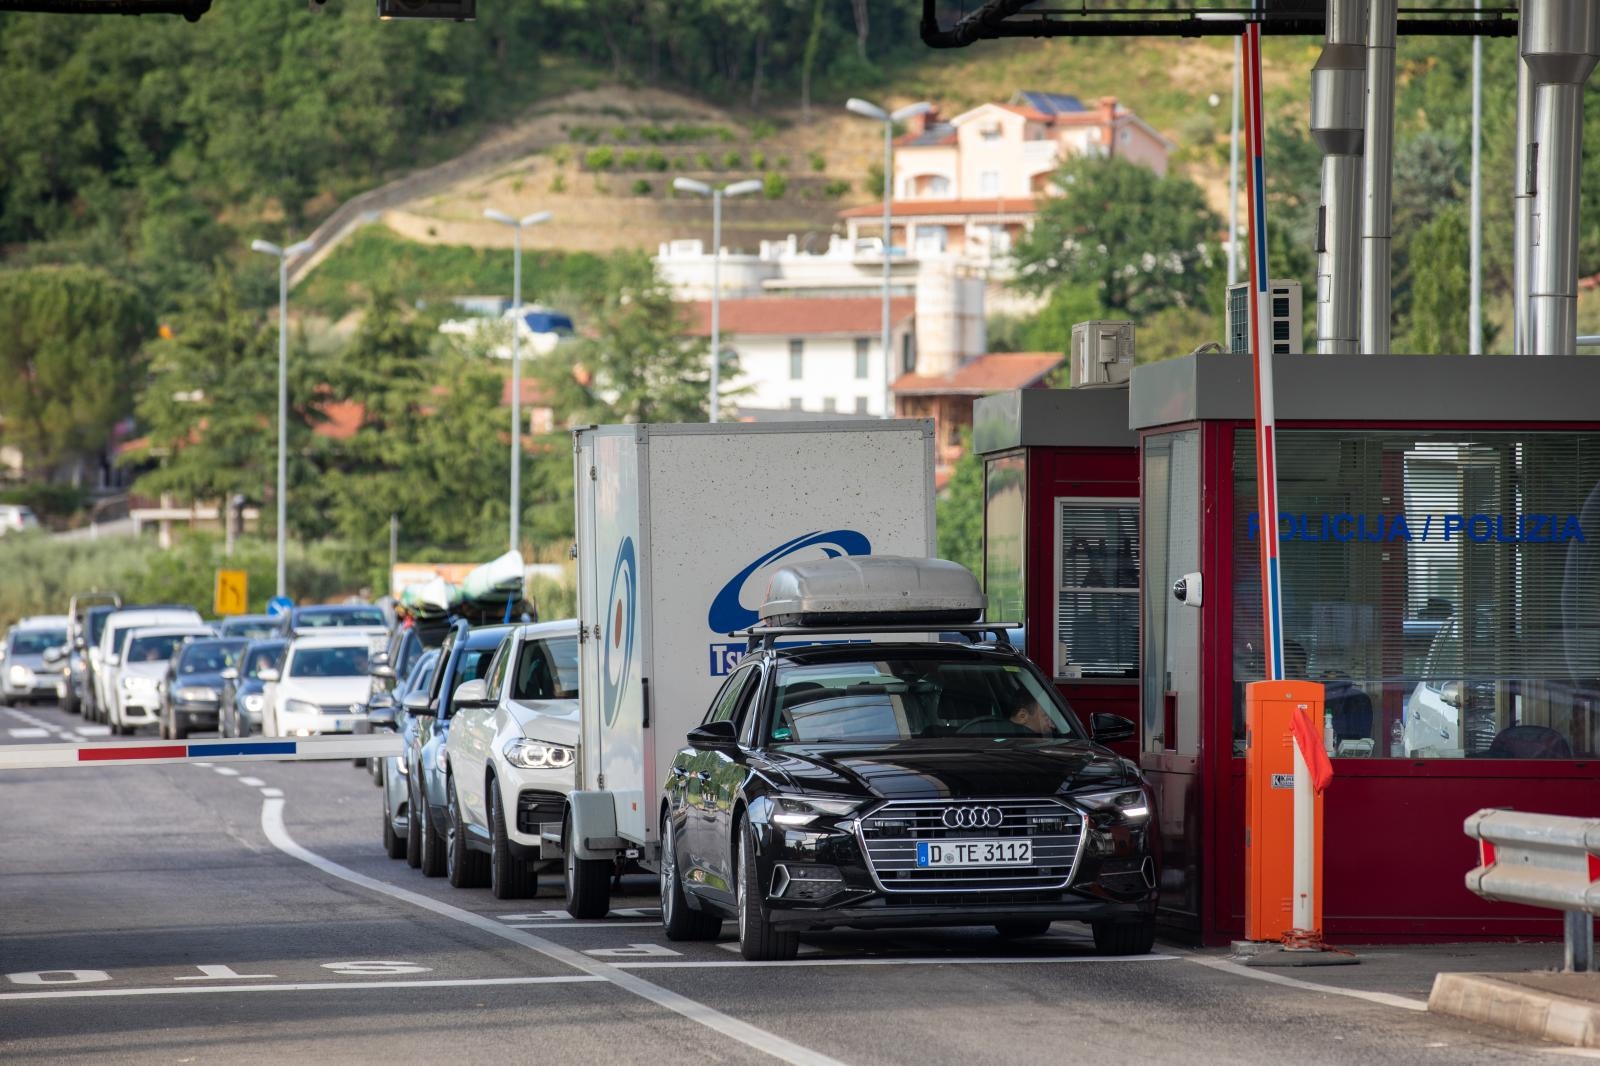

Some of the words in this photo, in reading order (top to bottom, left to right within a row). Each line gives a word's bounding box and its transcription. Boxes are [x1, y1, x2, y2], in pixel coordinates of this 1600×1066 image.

[1247, 512, 1412, 542] POLICIJA
[1422, 514, 1432, 542] /
[1444, 514, 1585, 542] POLIZIA
[930, 845, 942, 863] D
[955, 844, 979, 863] TE
[984, 843, 1030, 862] 3112
